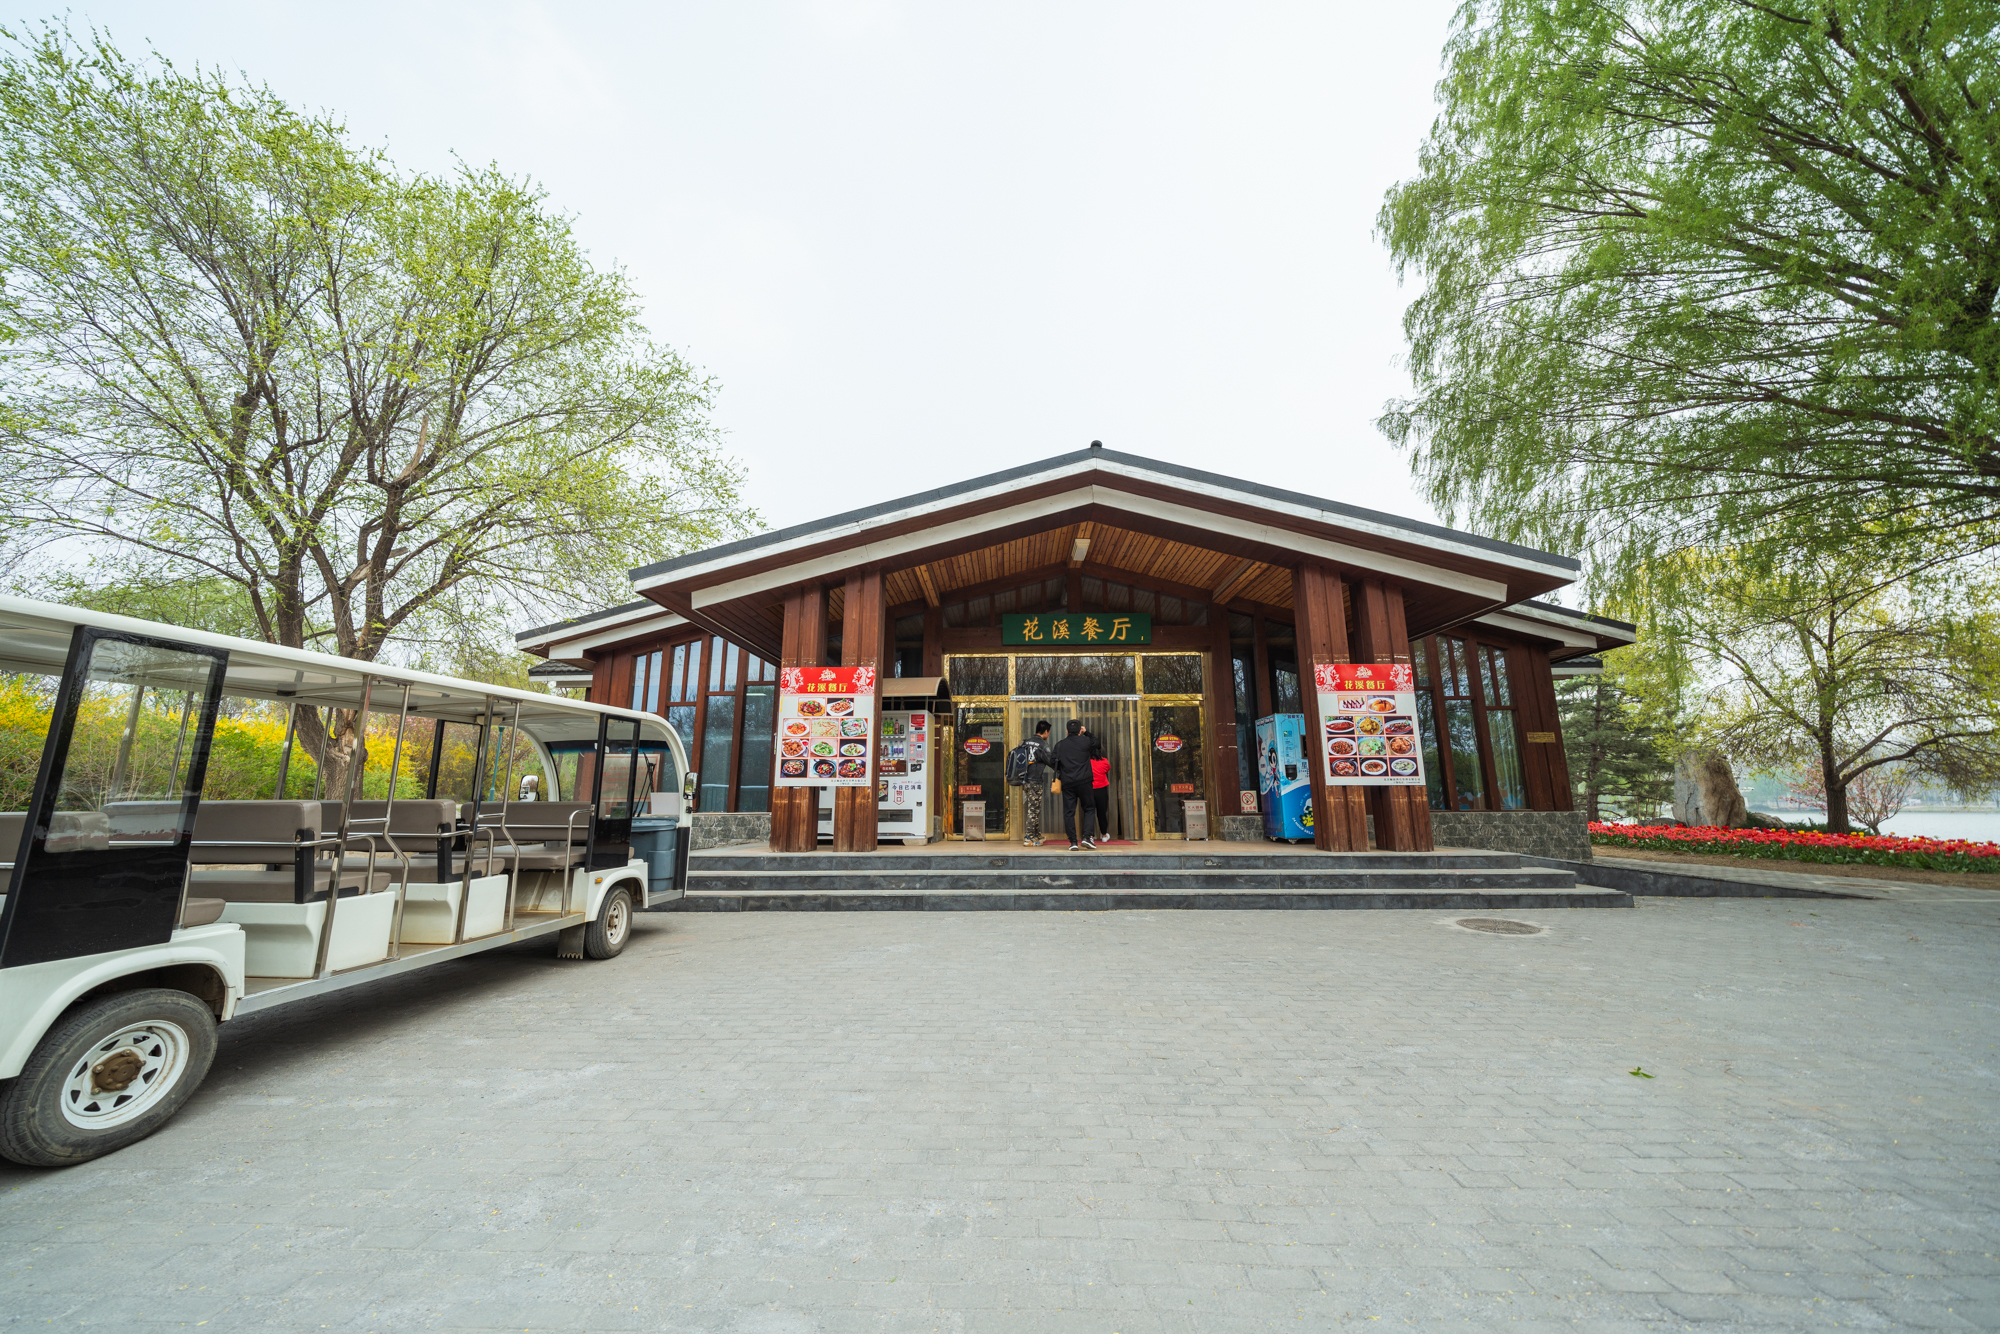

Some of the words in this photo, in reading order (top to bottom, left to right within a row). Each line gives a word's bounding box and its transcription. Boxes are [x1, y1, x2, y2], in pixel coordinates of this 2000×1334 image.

[1022, 616, 1132, 642] 花溪餐厅
[807, 683, 848, 693] 花溪餐厅
[1344, 680, 1386, 690] 花溪餐厅
